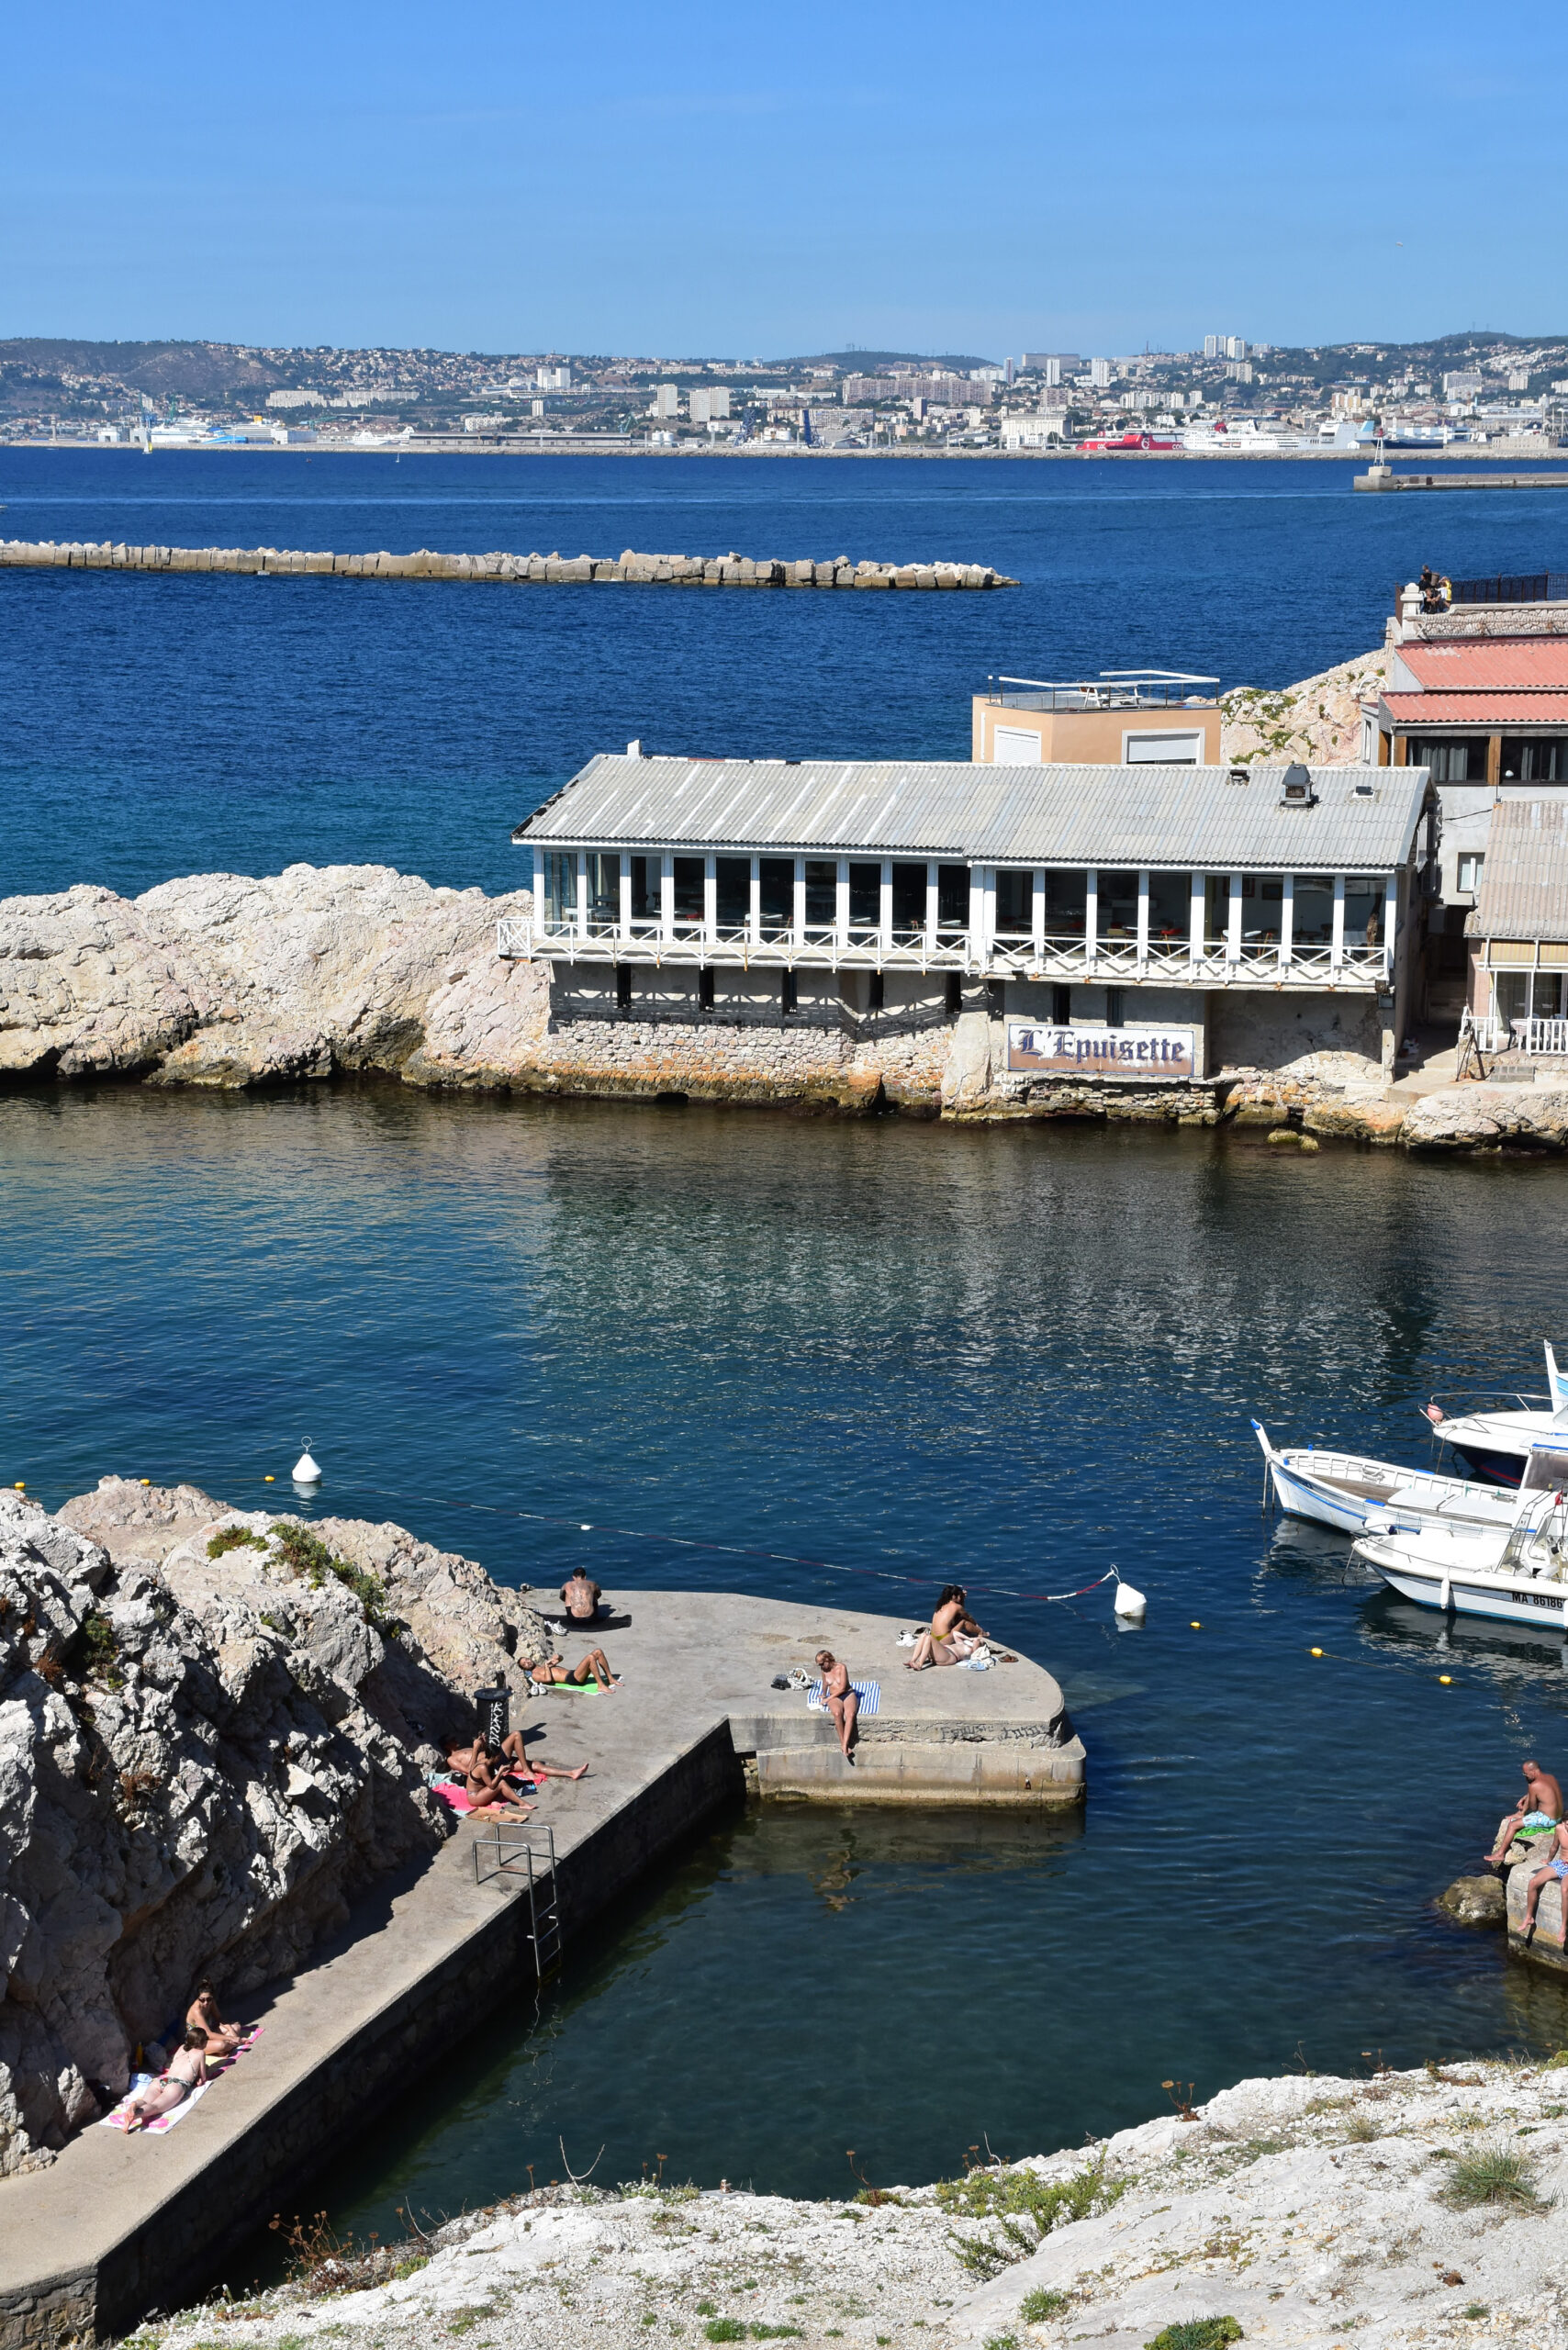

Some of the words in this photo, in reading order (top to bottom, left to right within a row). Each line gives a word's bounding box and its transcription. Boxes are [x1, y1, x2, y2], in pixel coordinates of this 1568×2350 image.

[1018, 1029, 1184, 1063] L'Epuisette
[1512, 1592, 1529, 1604] MA
[1533, 1595, 1564, 1608] 86186
